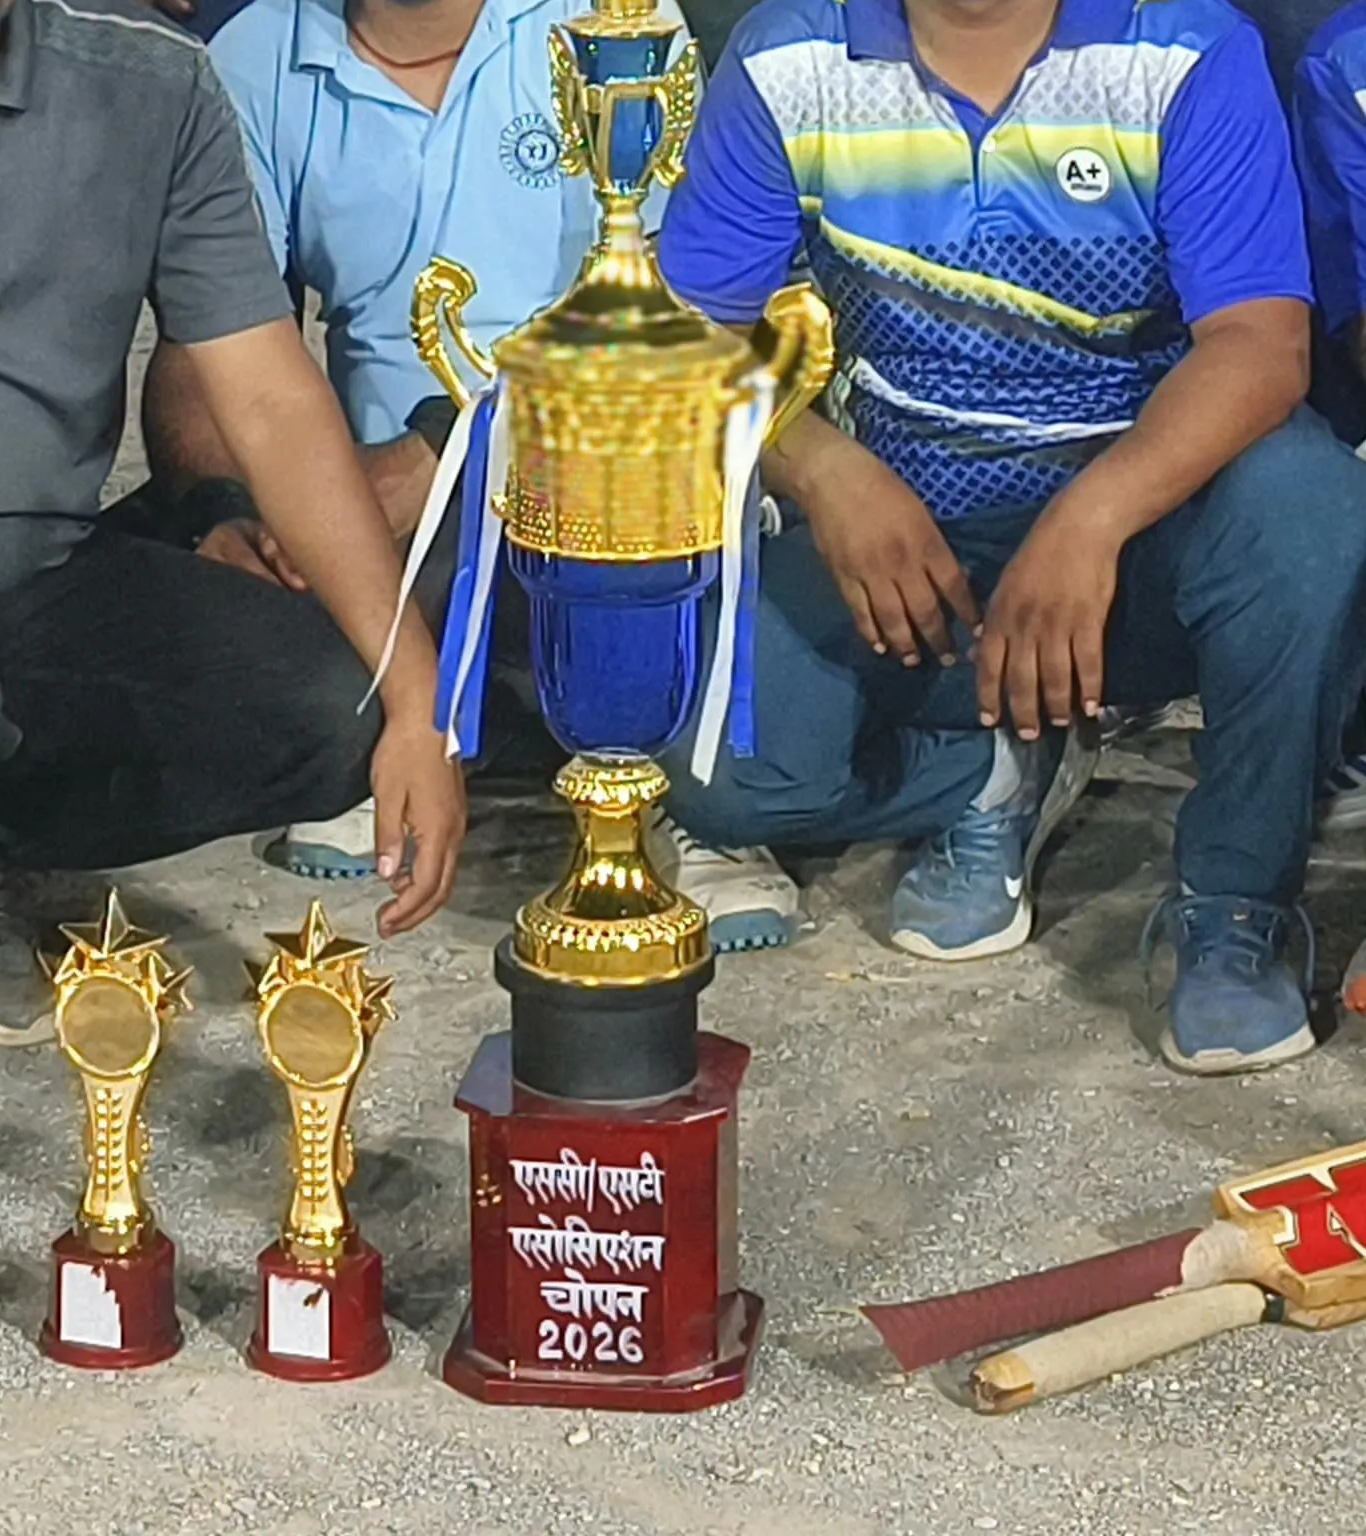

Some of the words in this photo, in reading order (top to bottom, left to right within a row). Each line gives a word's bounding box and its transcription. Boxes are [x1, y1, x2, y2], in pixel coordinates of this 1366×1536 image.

[1066, 160, 1102, 182] A+
[507, 1213, 666, 1275] एसोसिएशन
[540, 1267, 649, 1322] चोपन
[538, 1319, 644, 1363] 2026
